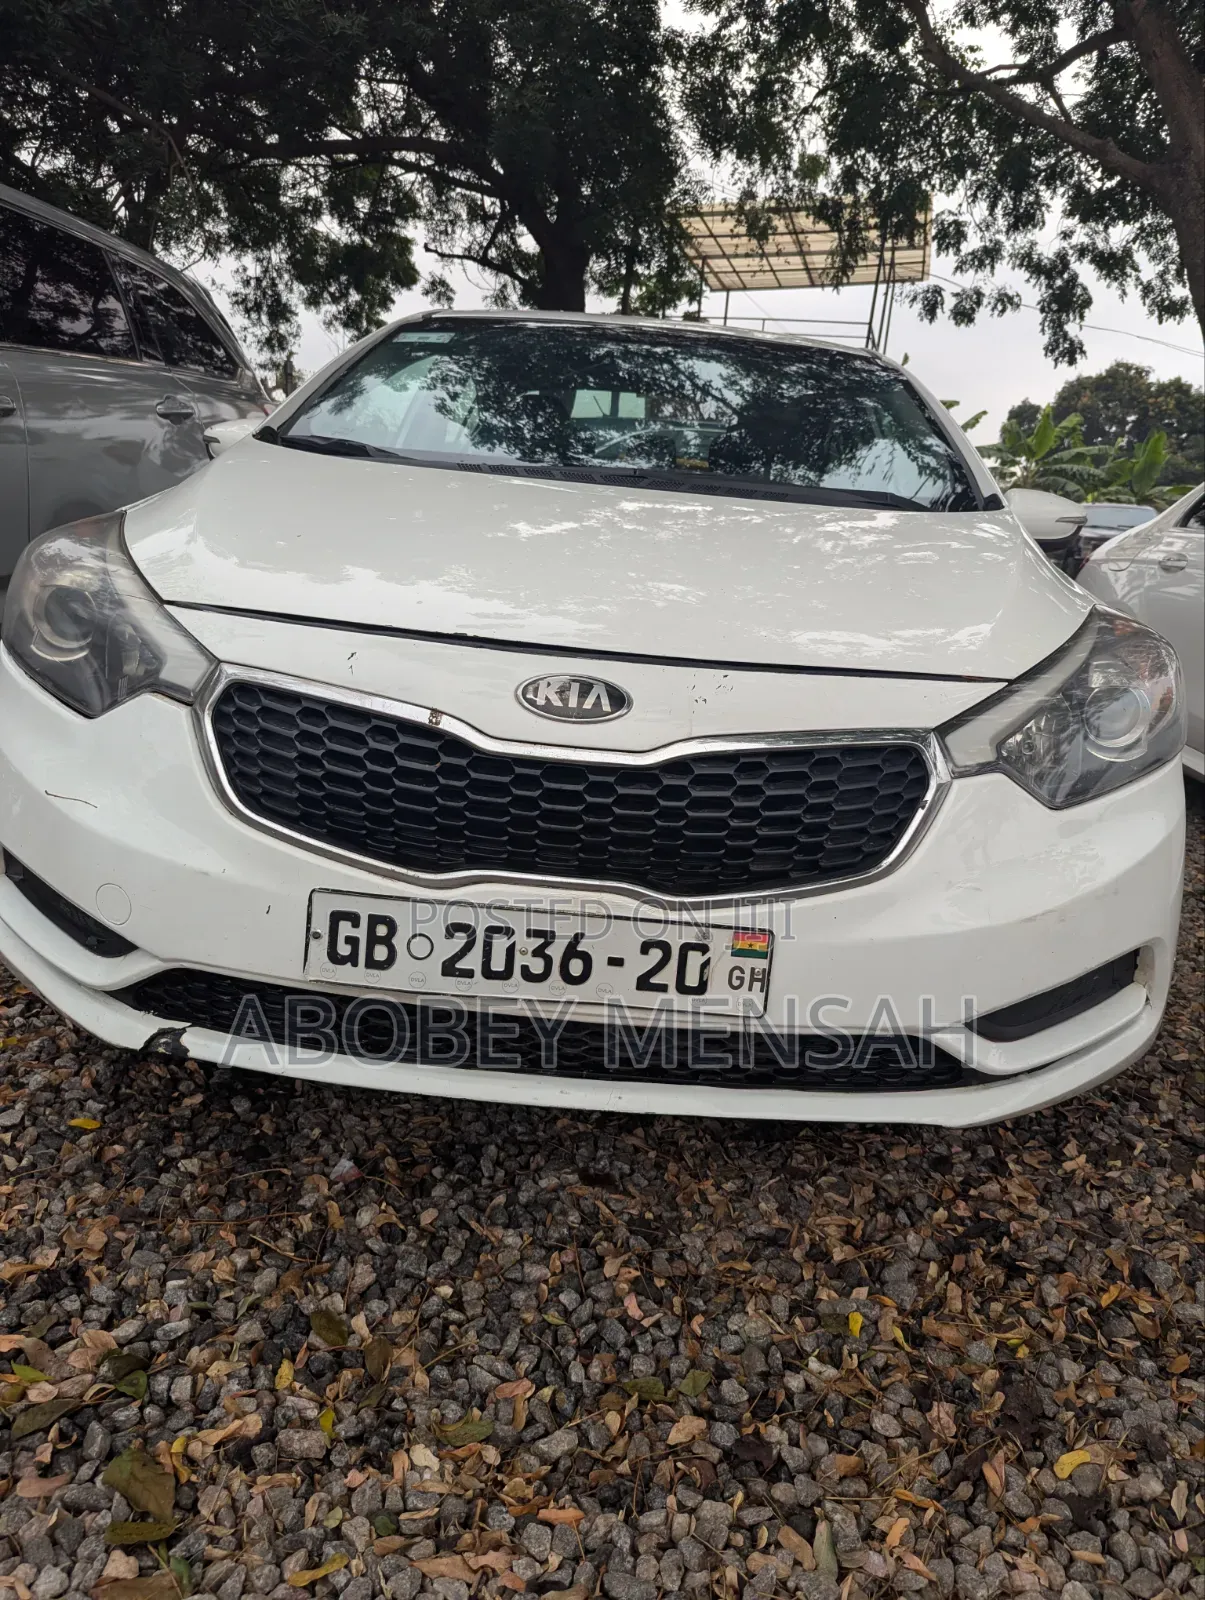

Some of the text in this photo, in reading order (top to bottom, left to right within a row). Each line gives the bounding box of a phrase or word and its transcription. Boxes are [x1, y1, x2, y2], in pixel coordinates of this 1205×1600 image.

[536, 680, 612, 712] KIA
[327, 910, 397, 970] GB
[727, 965, 767, 993] GH
